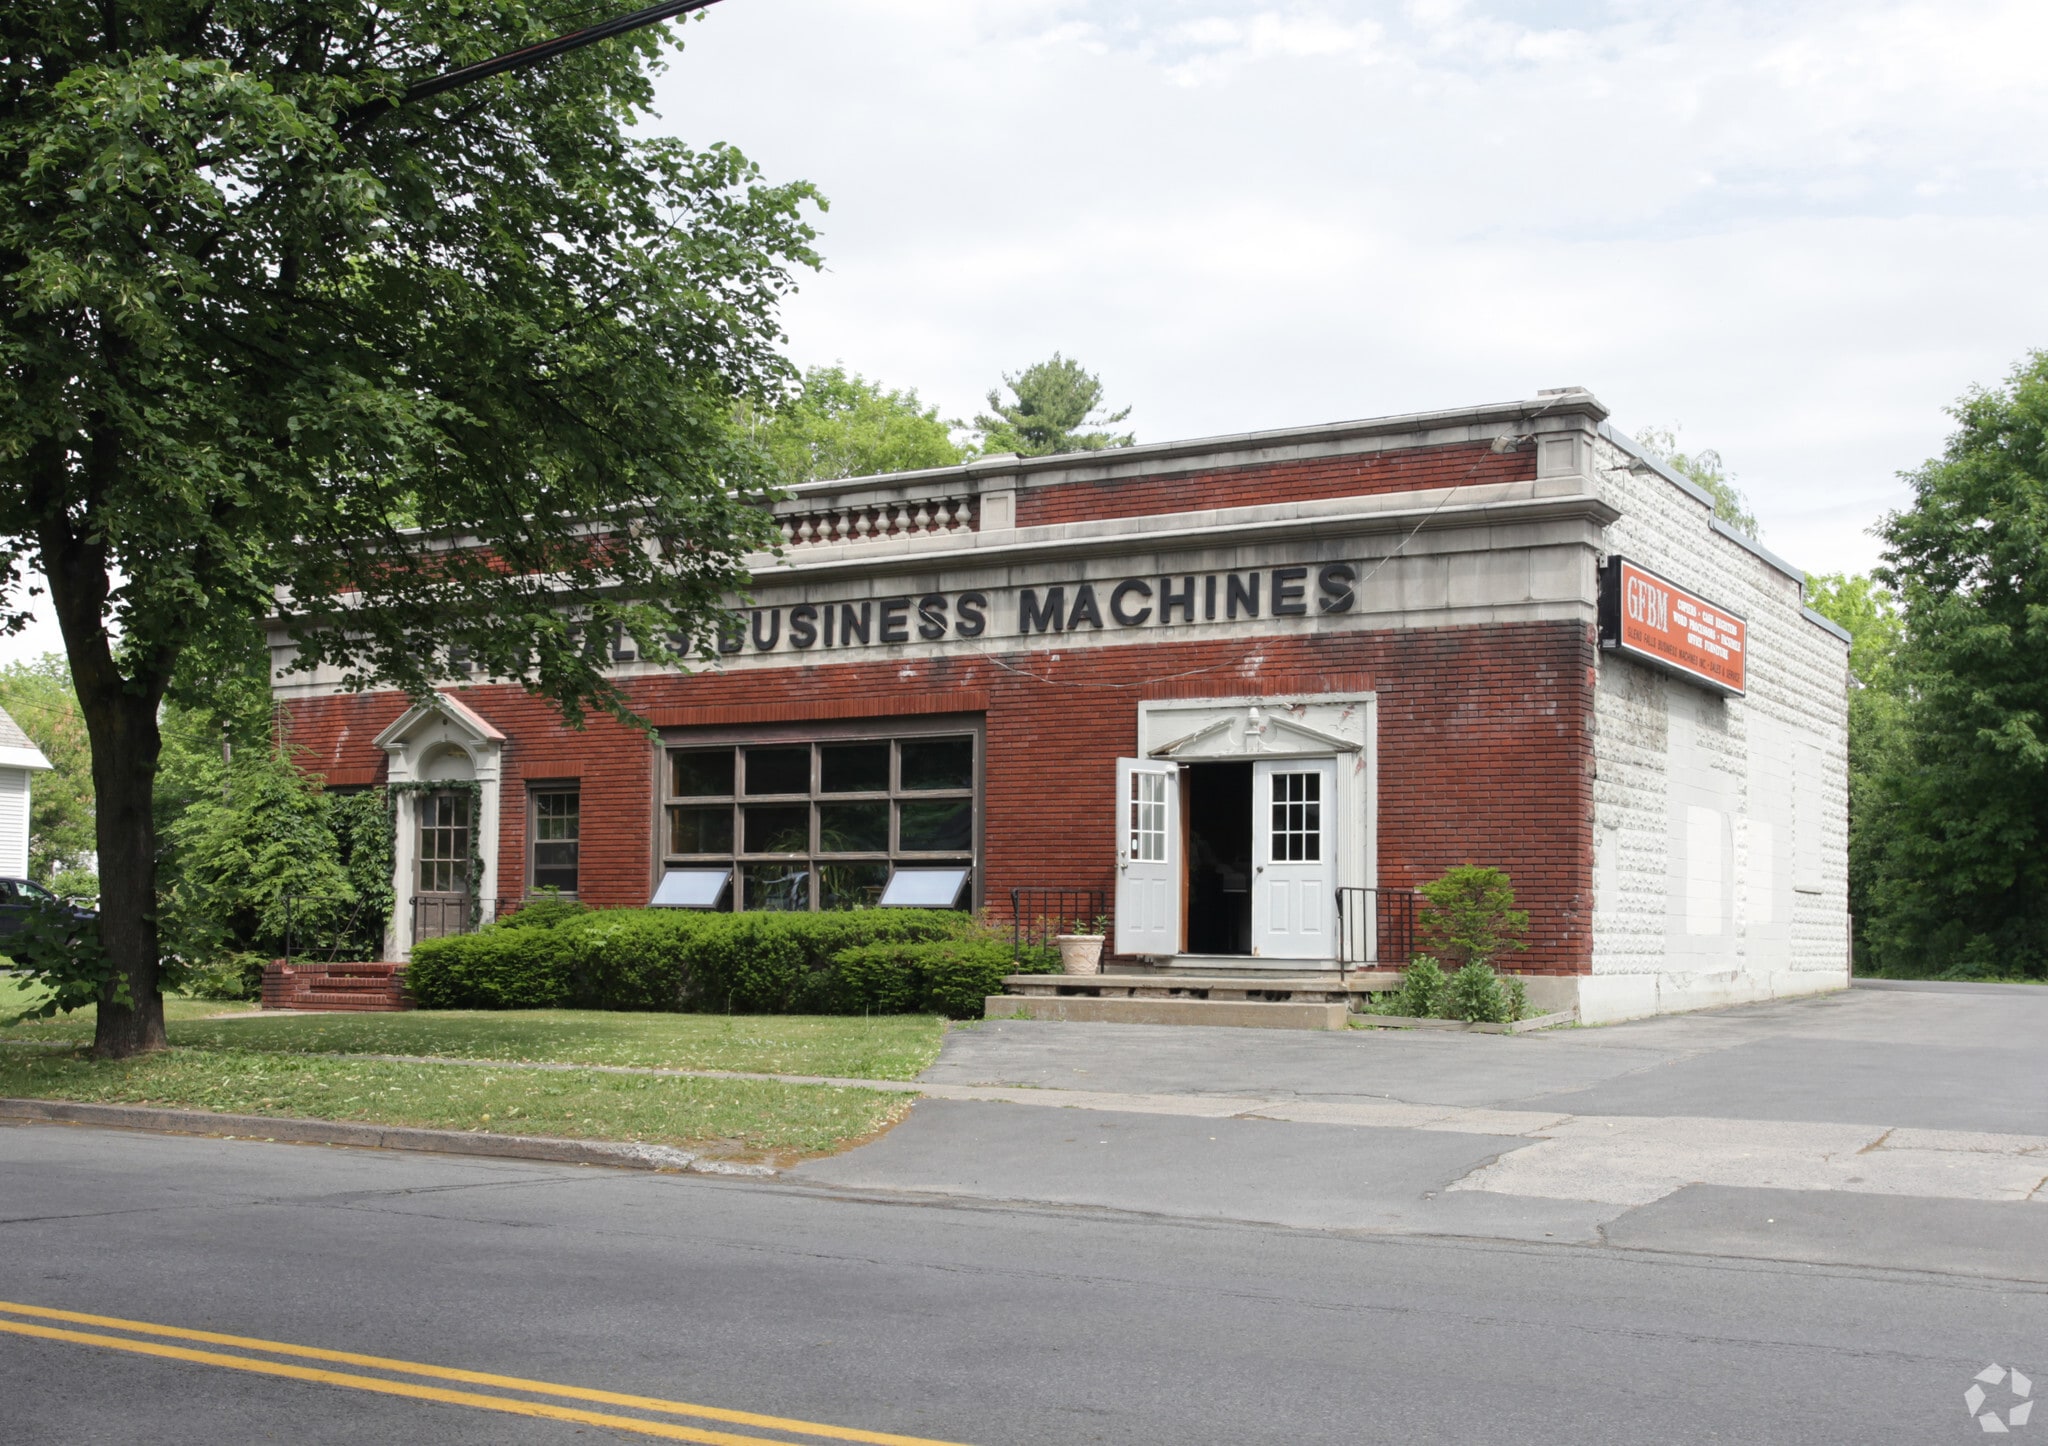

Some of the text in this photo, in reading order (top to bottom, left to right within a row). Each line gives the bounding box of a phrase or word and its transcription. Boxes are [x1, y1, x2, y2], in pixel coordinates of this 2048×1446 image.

[718, 592, 987, 653] BUSINESS
[1019, 562, 1356, 633] MACHINES
[1627, 575, 1669, 633] GFBM
[1627, 626, 1643, 642] GLENS
[1643, 633, 1656, 648] FALLS
[1658, 640, 1677, 658] BUSINESS
[1678, 648, 1698, 667] MACHINES
